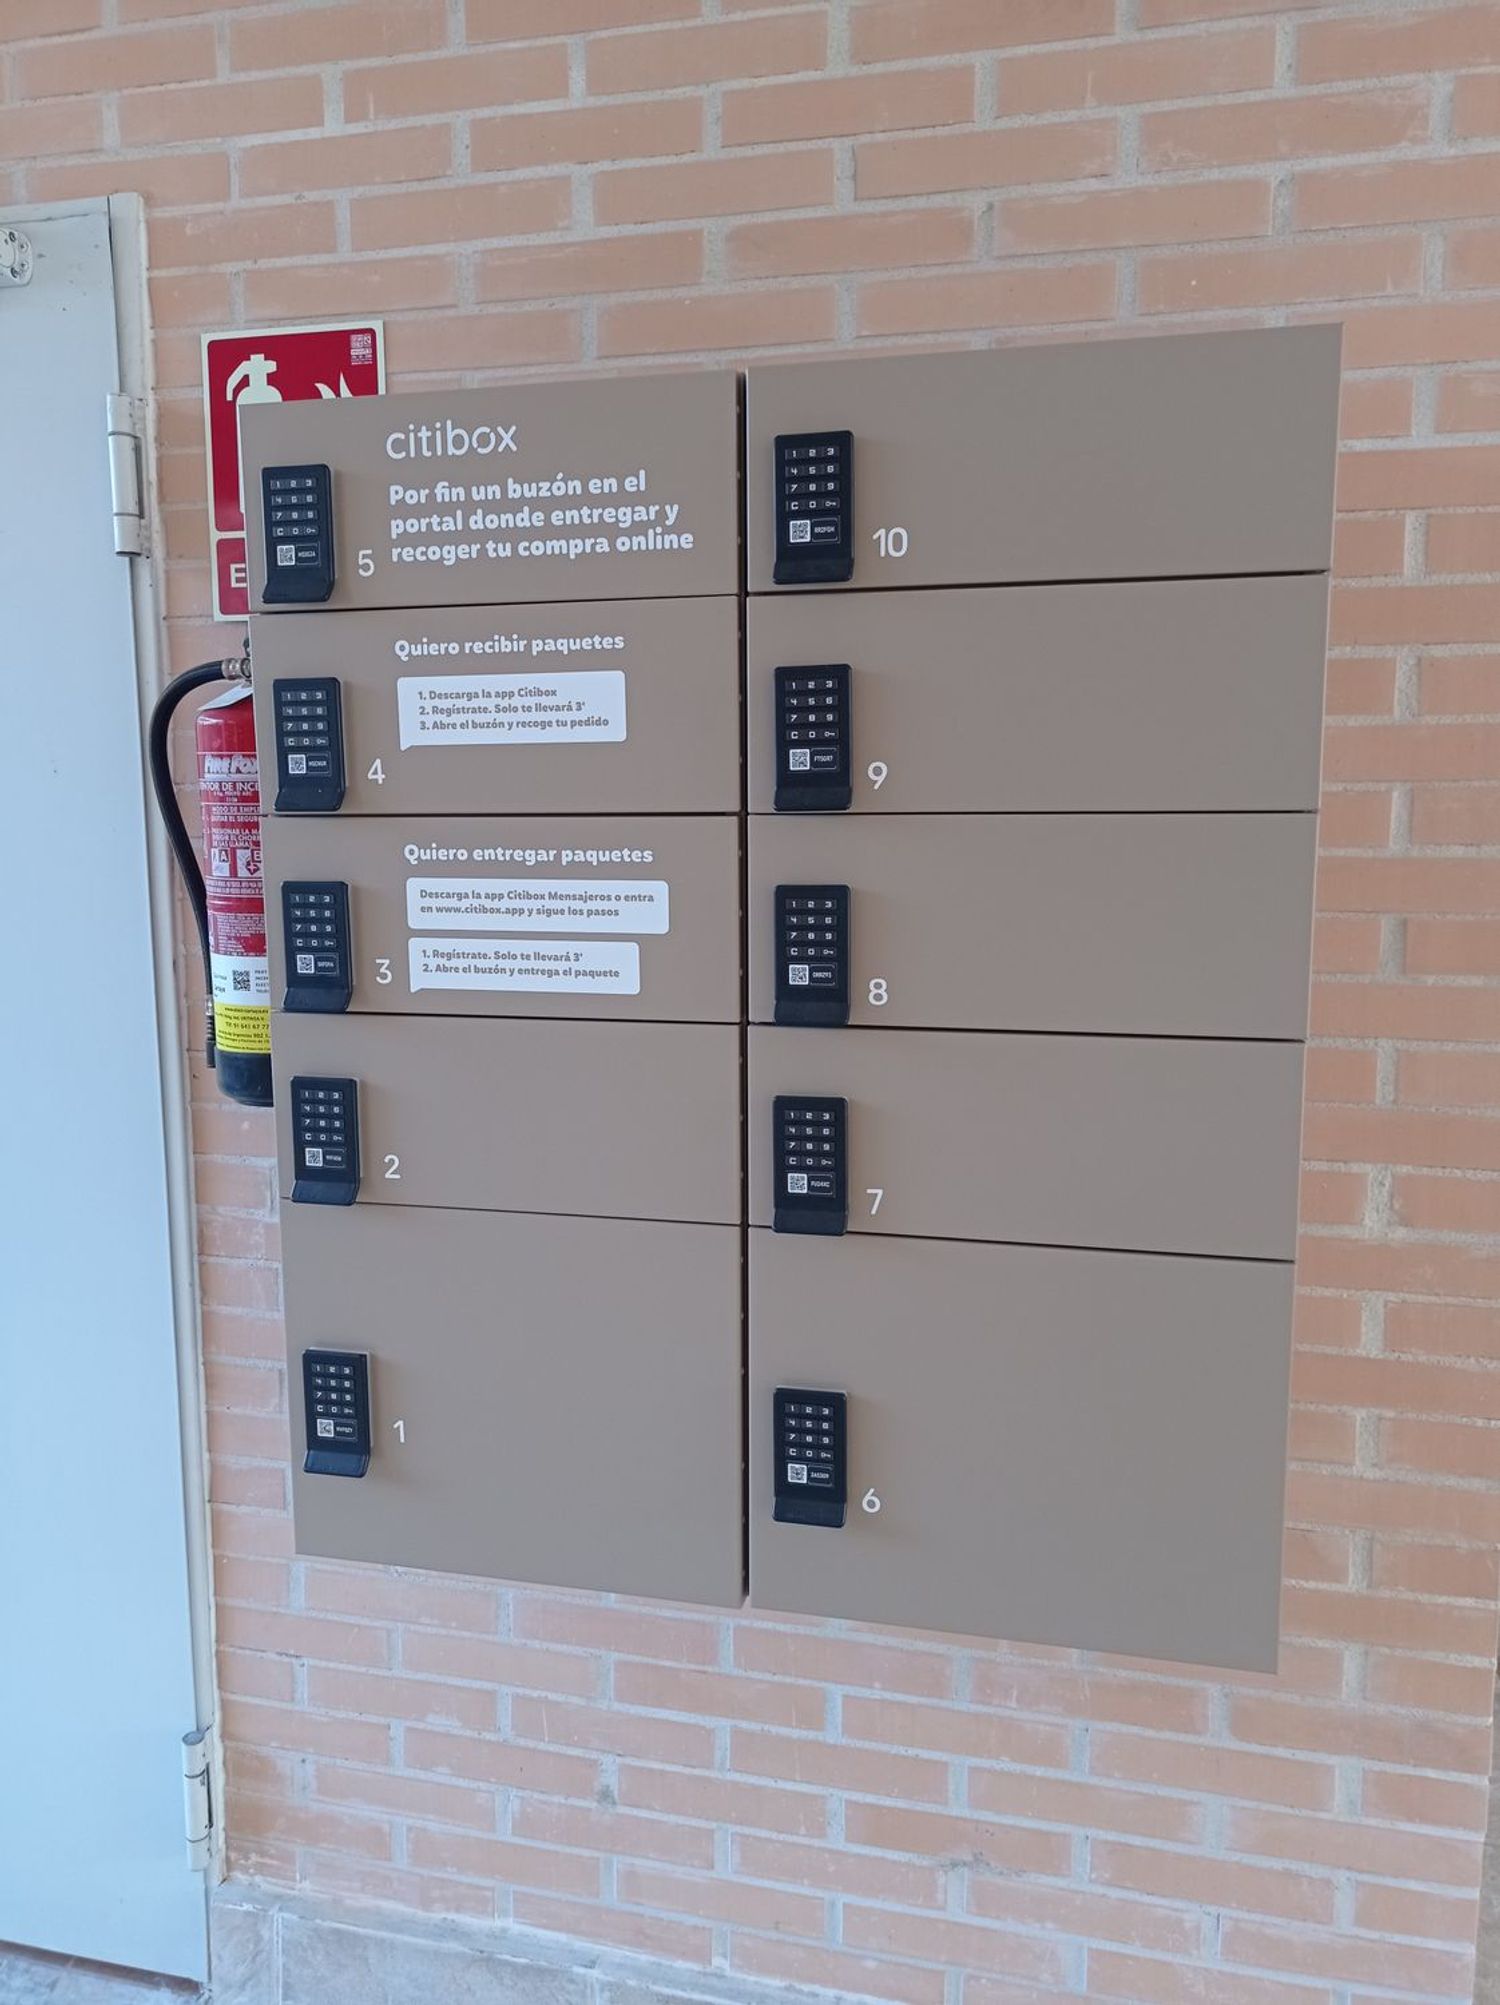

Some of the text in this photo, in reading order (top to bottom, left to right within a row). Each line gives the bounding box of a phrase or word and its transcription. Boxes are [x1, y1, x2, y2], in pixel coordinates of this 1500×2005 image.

[386, 419, 517, 459] citibox
[389, 469, 646, 505] Por fin un buzón en el
[791, 484, 798, 492] 7
[791, 502, 798, 510] C
[390, 503, 679, 539] portal donde entregar y
[391, 527, 694, 565] recoger tu compra online
[873, 527, 908, 557] 10
[359, 549, 374, 577] 5
[394, 634, 625, 661] Quiero recibir paquetes
[418, 686, 557, 702] 1. Descarga la app Citibox
[419, 706, 429, 715] 2.
[431, 703, 492, 717] Regístrate.
[494, 703, 519, 714] Solo
[521, 704, 533, 713] te
[534, 700, 573, 712] llevará
[420, 716, 609, 731] 3. Abre el buzón y recoge tu pedido
[367, 758, 386, 784] 4
[868, 761, 888, 790] 9
[403, 842, 654, 866] Quiero entregar paquetes
[419, 889, 654, 903] Descarga la app Citibox Mensajeros o entra
[420, 904, 619, 918] en www.citibox.app y sigue los pasos
[422, 949, 431, 958] 1.
[432, 949, 492, 962] Regístrate.
[493, 950, 518, 961] Solo
[519, 952, 532, 961] te
[533, 950, 571, 962] llevará
[376, 959, 392, 984] 3
[422, 963, 620, 979] 2. Abre el buzón y entrega el paquete
[868, 979, 888, 1005] 8
[384, 1154, 401, 1179] 2
[866, 1189, 883, 1215] 7
[393, 1420, 404, 1443] 1
[862, 1488, 880, 1513] 6
